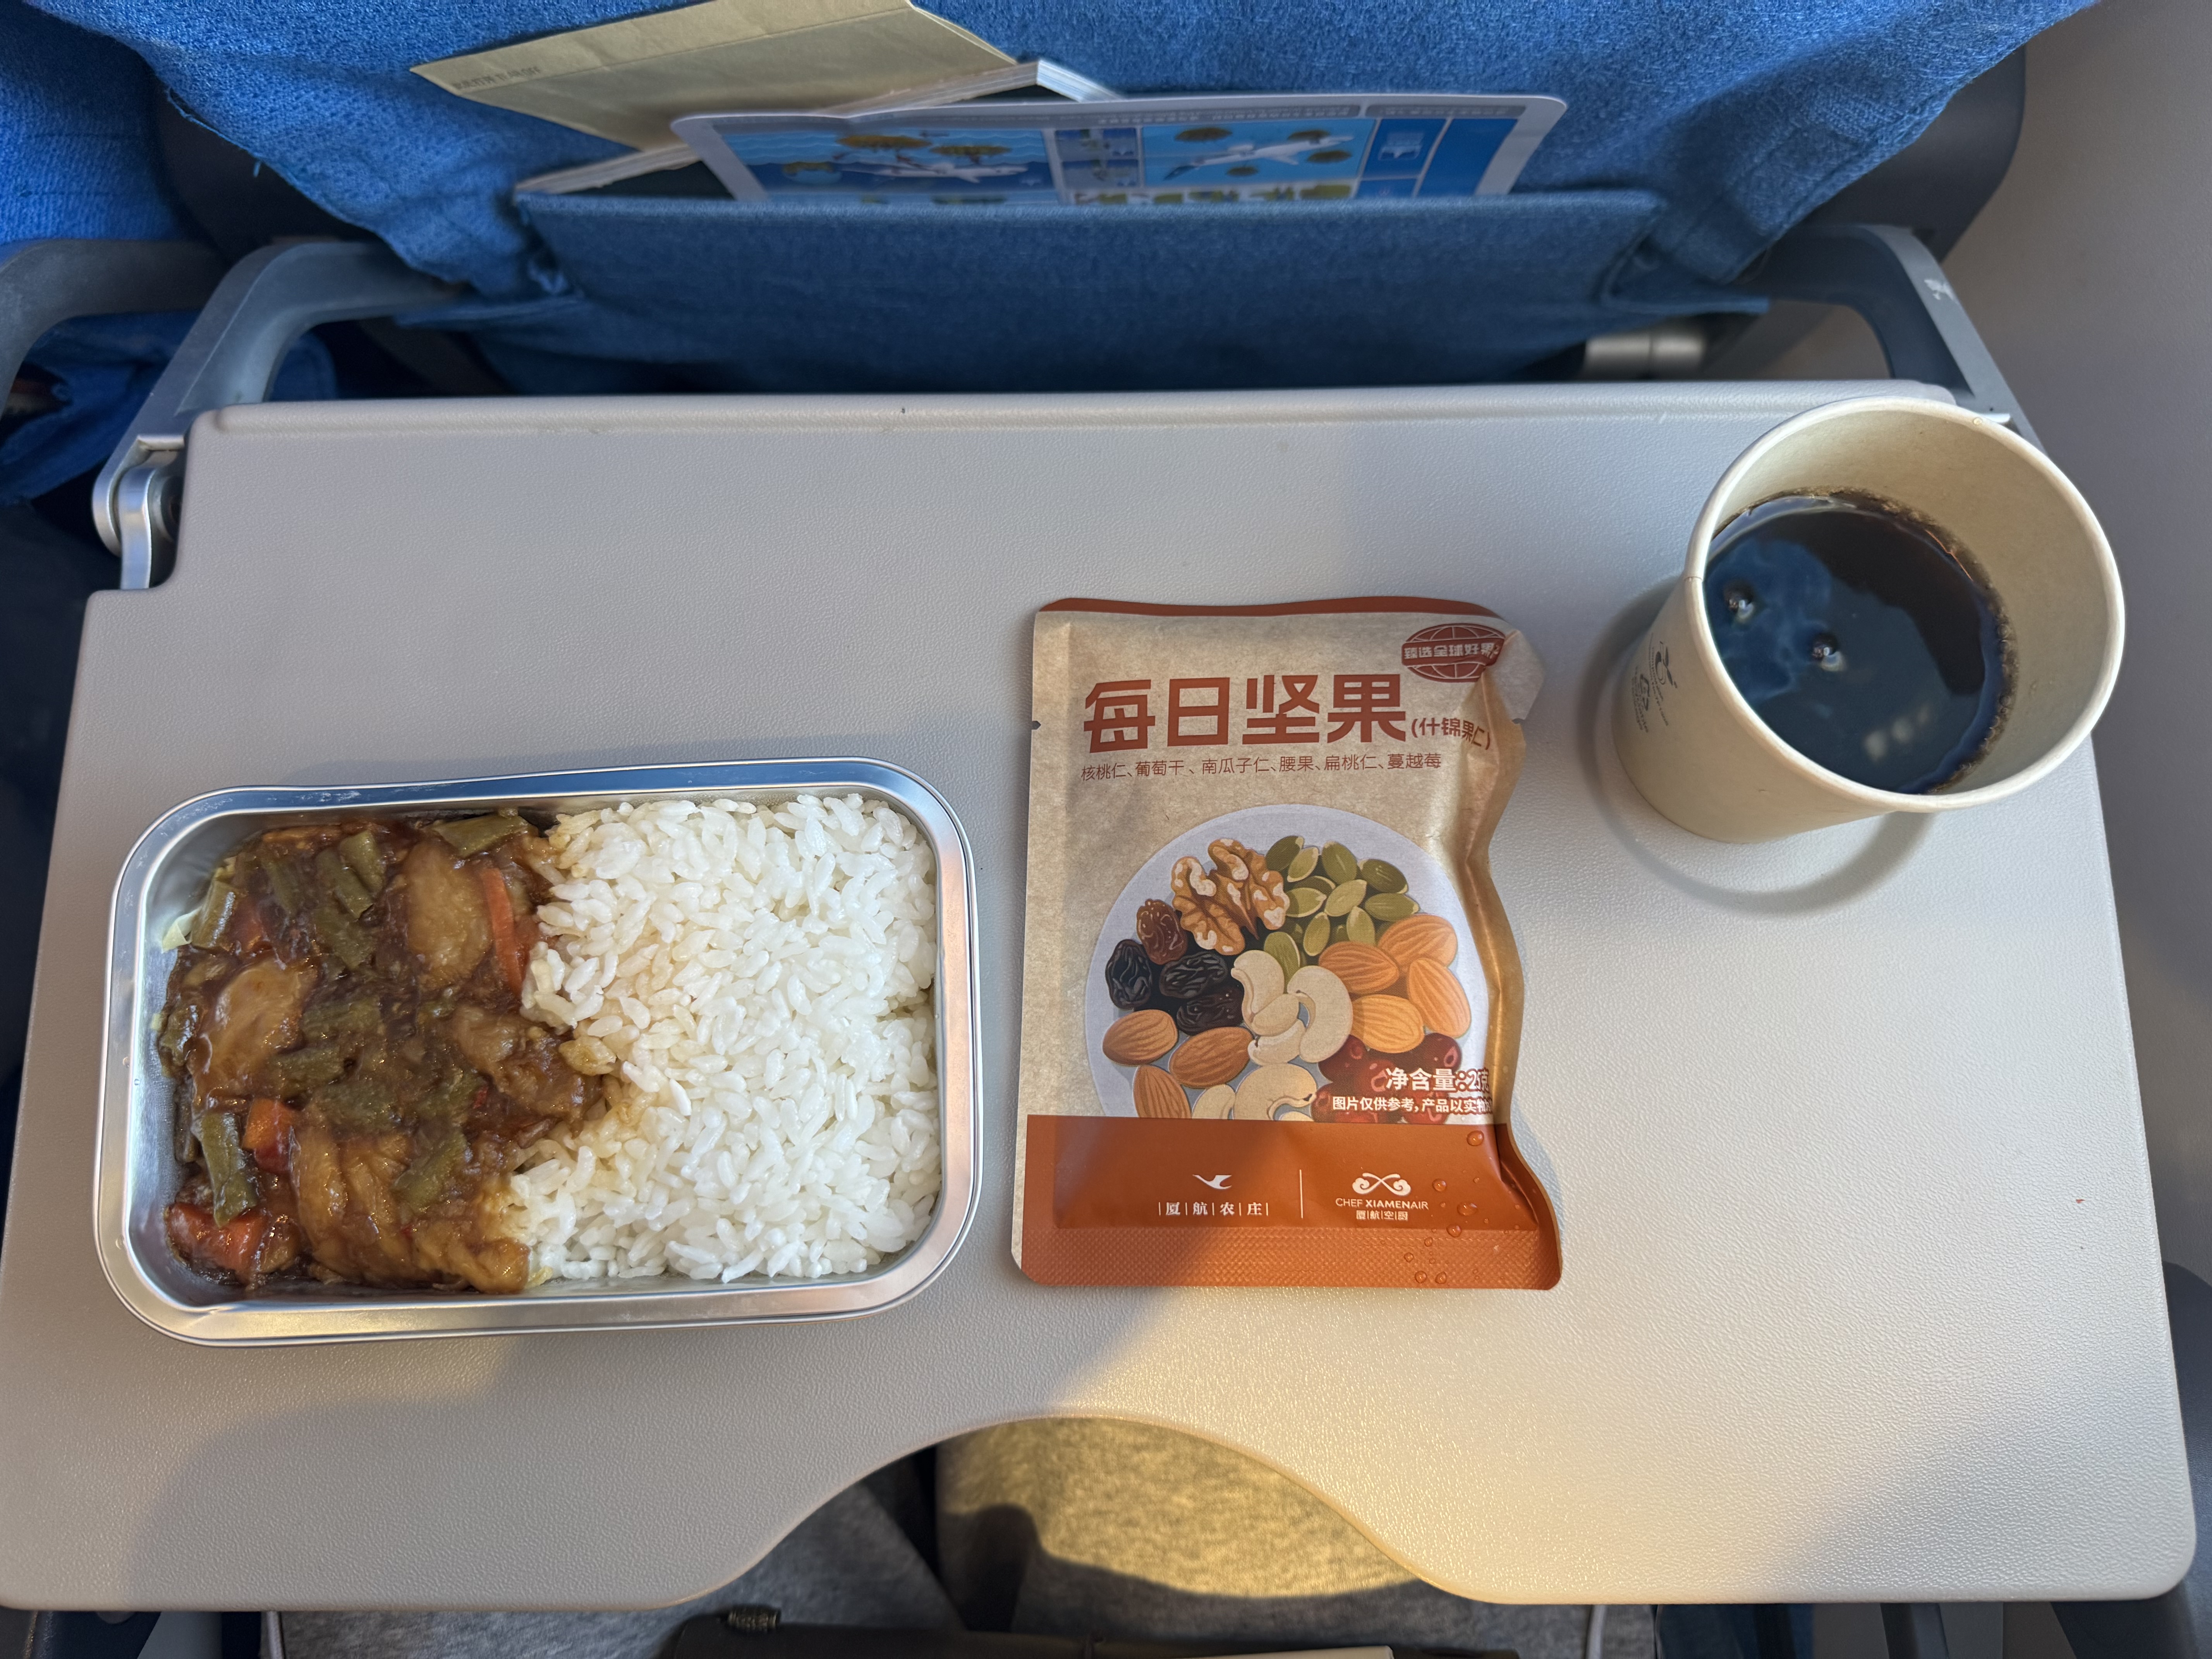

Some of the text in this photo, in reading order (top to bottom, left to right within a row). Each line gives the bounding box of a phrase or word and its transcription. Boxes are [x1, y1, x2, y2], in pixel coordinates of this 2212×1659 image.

[1084, 674, 1406, 754] 每日坚果
[1336, 1198, 1429, 1210] CHEF XIAMENAIR
